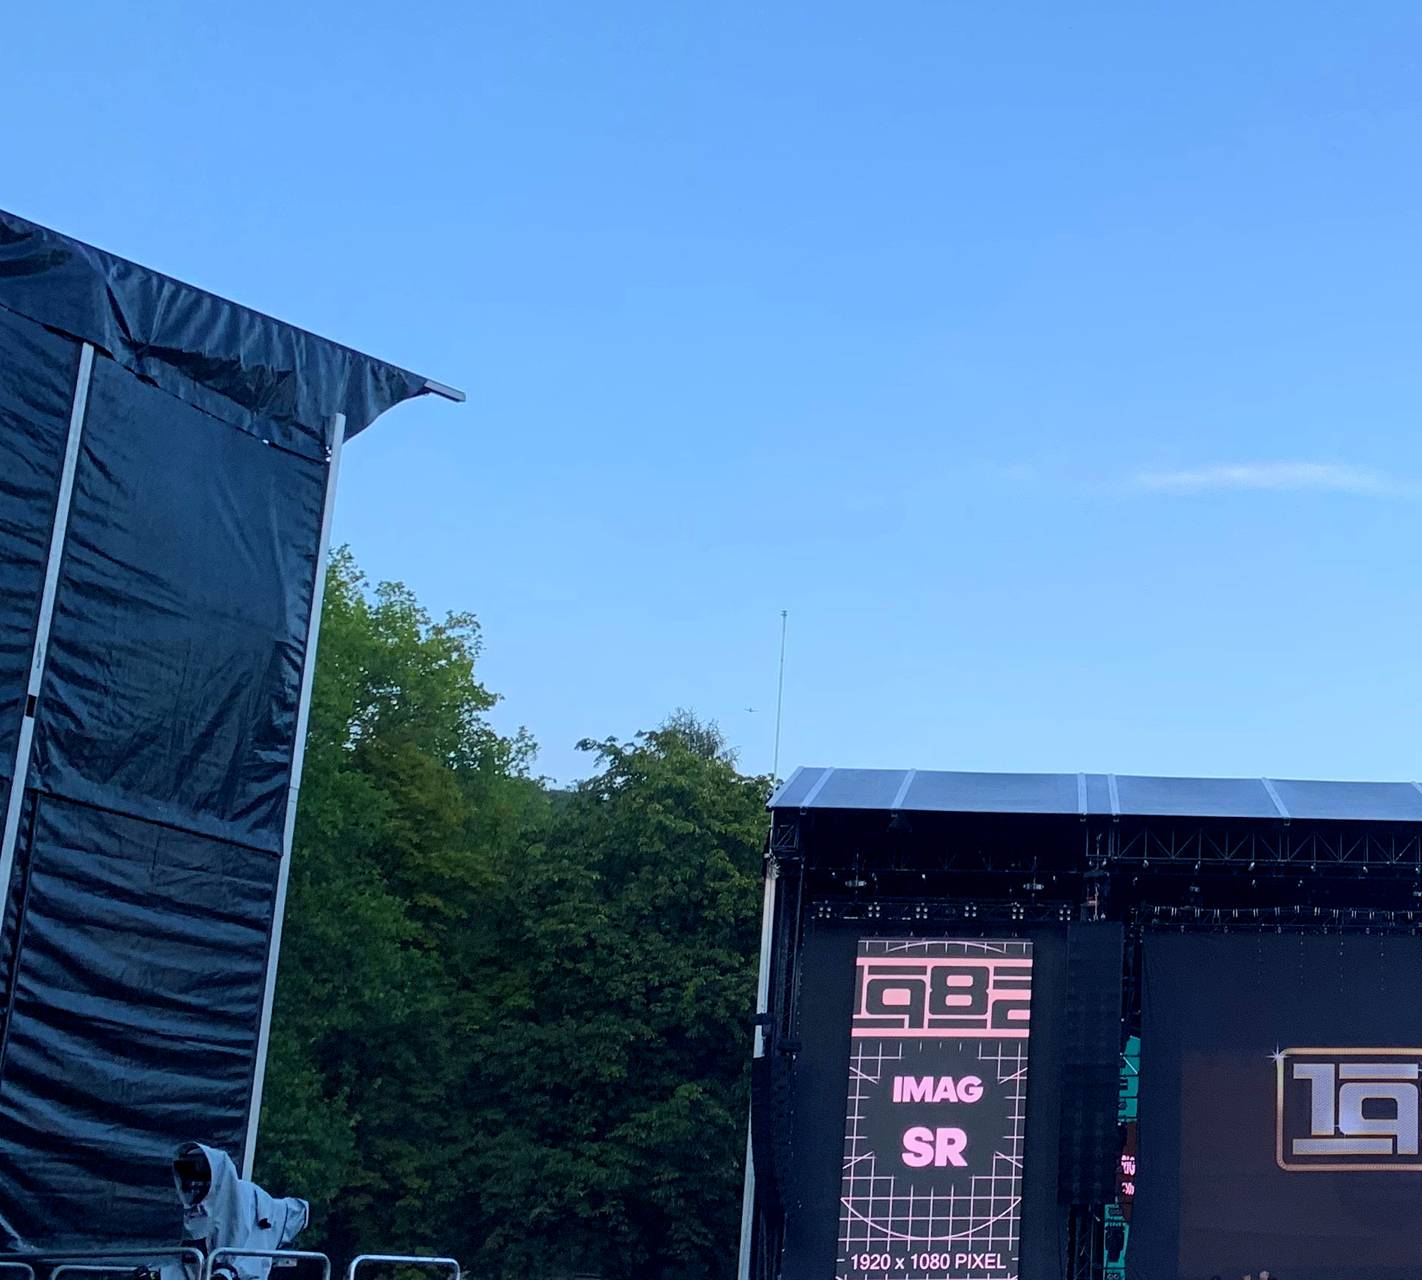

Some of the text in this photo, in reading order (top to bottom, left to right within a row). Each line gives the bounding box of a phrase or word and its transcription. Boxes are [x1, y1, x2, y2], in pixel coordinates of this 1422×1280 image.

[892, 1075, 985, 1104] IMAG
[901, 1126, 968, 1168] SR
[850, 1252, 1007, 1271] 1920 x 1080 PIXEL
